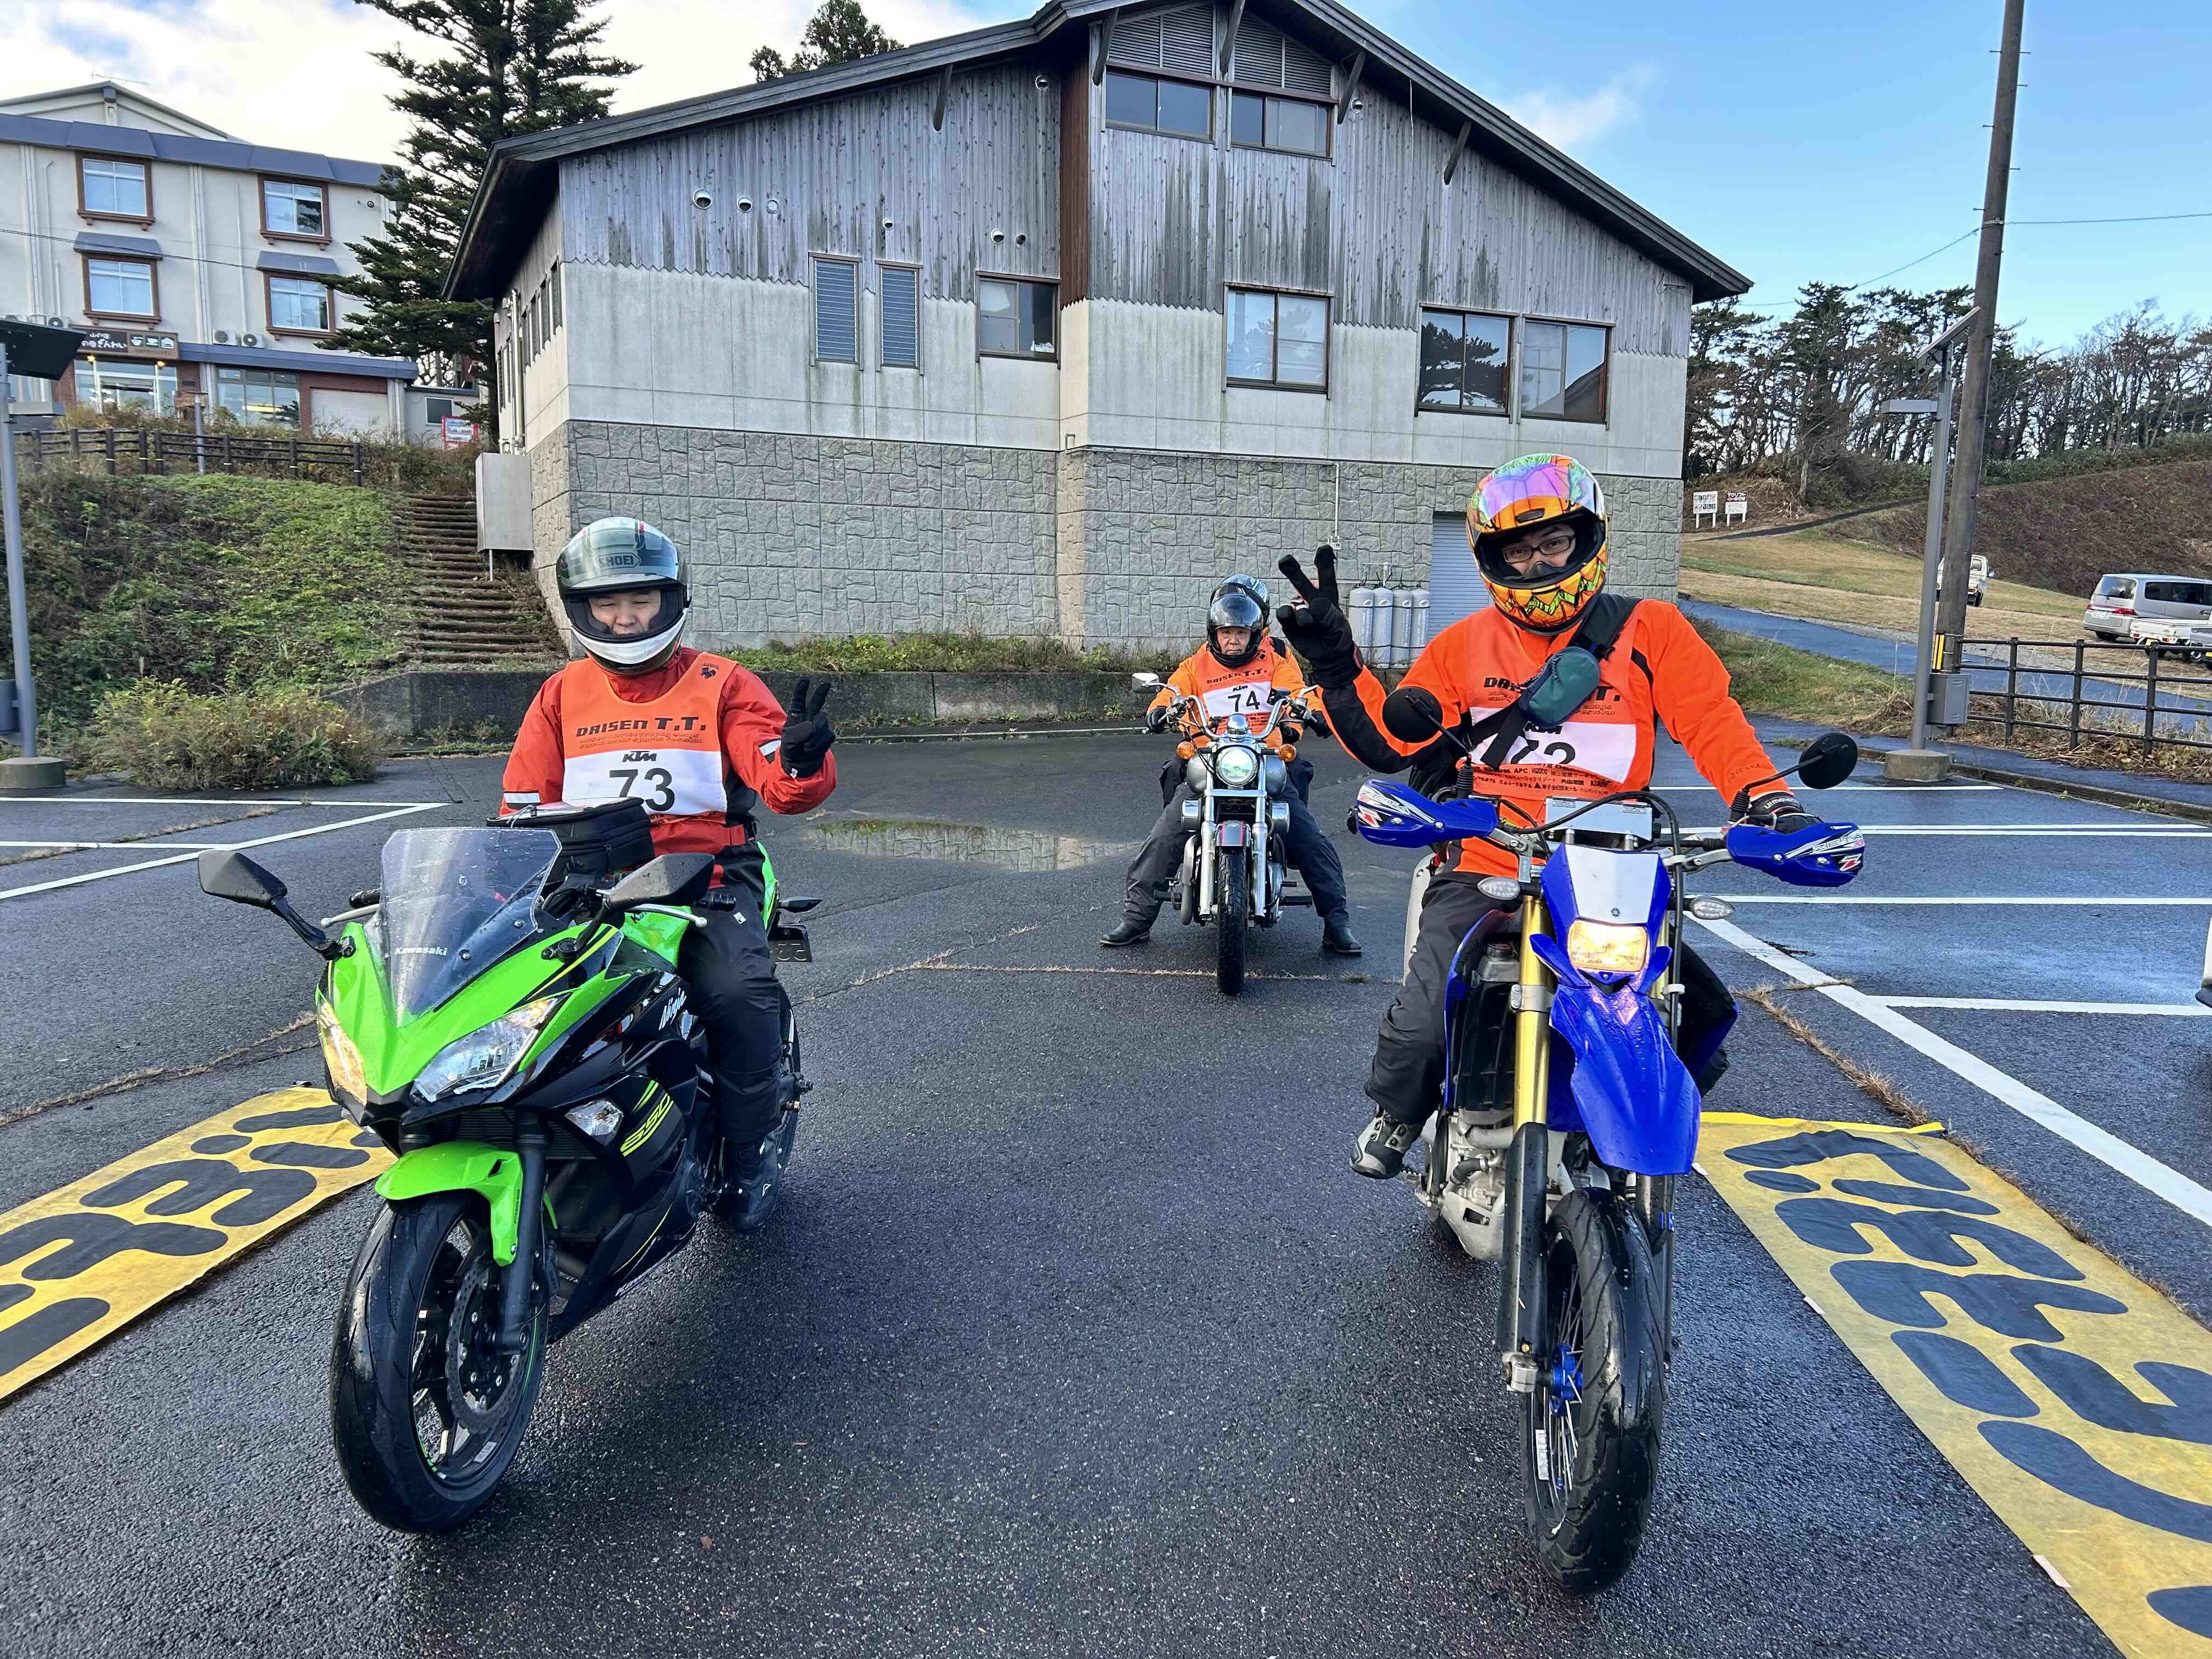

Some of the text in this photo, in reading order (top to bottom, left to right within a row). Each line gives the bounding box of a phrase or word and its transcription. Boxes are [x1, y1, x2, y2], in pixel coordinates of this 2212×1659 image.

[599, 555, 634, 567] SHOEI
[1228, 691, 1260, 712] 74
[576, 716, 707, 737] DAISEN T.T.
[622, 751, 657, 763] KTM
[610, 768, 675, 811] 73
[394, 946, 448, 956] Kawasaki
[658, 987, 686, 1030] Ninja
